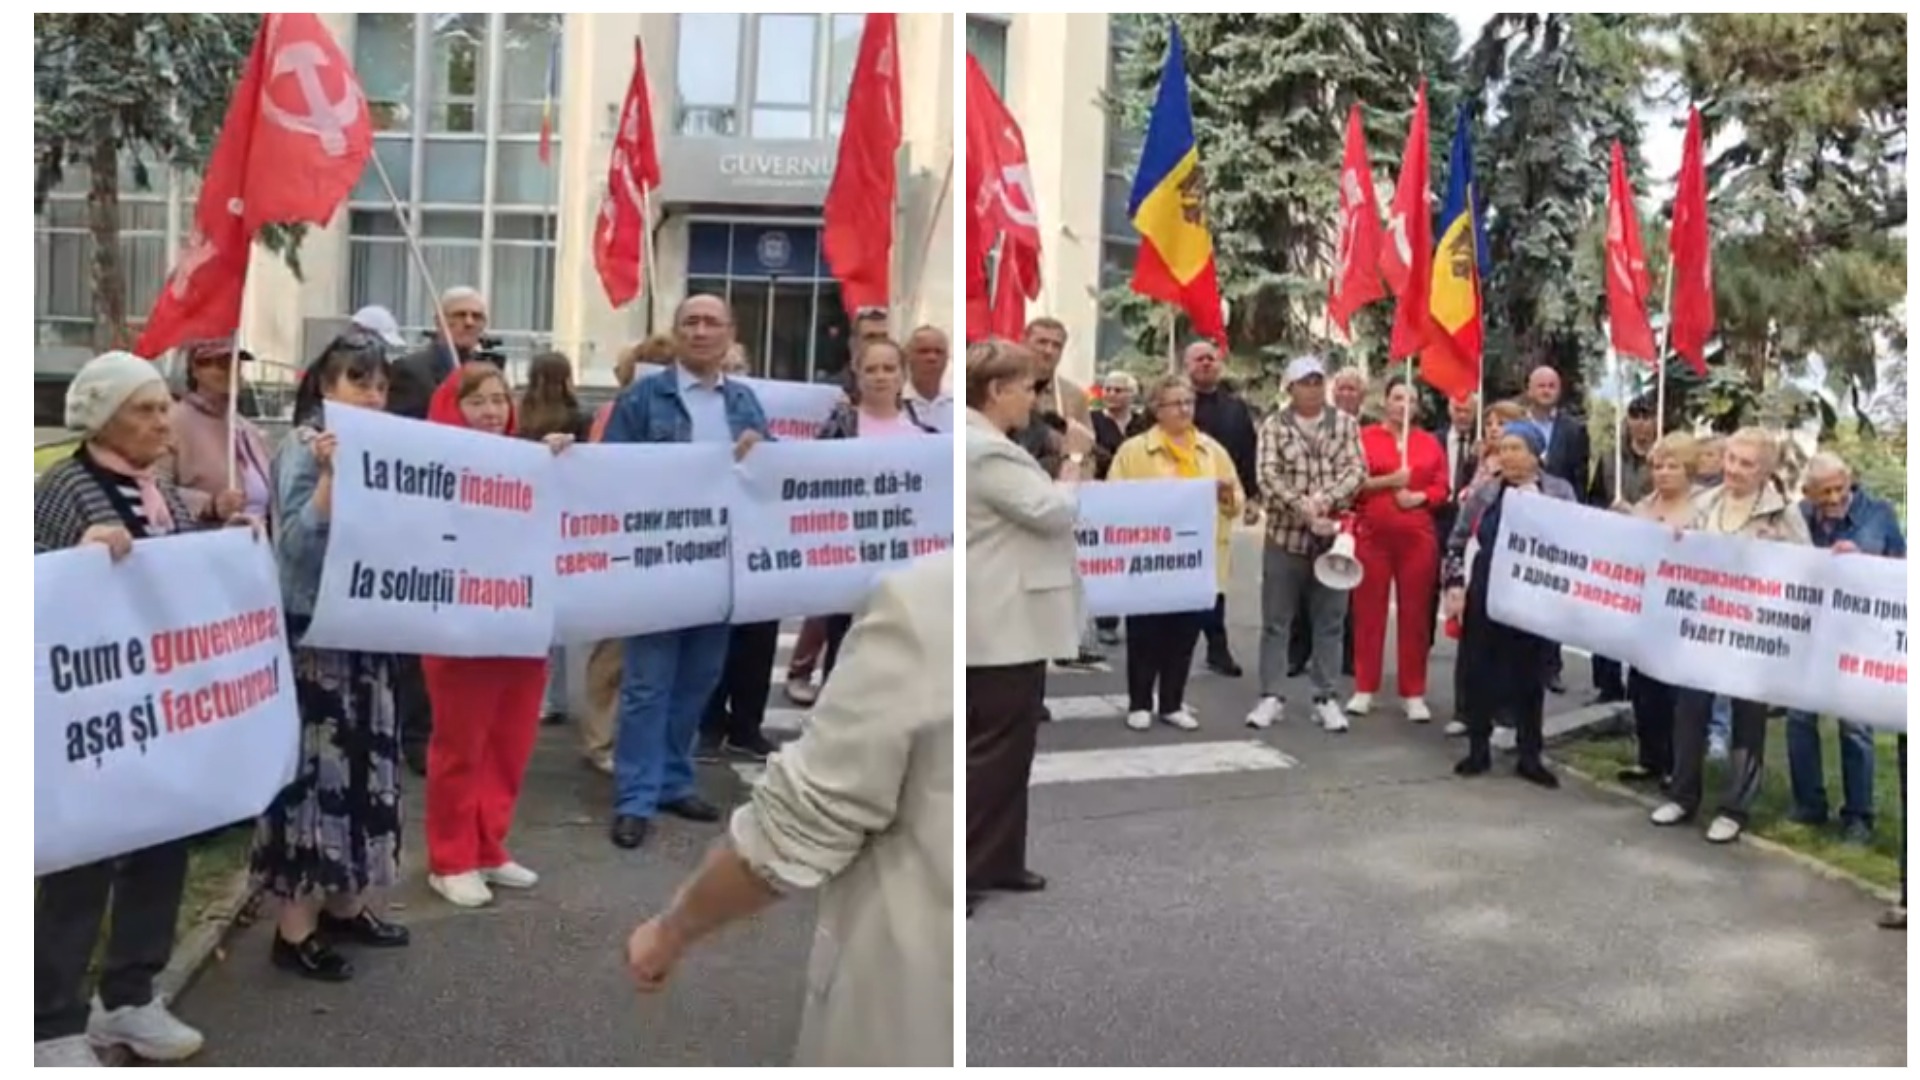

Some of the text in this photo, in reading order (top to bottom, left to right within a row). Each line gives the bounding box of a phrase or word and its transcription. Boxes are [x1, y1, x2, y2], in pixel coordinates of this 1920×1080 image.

[719, 152, 833, 176] GUVERNU
[362, 450, 389, 490] La
[395, 459, 457, 500] tarife
[560, 511, 620, 539] Готовь
[624, 510, 663, 533] сани
[719, 507, 728, 525] а
[790, 510, 849, 534] minte
[853, 509, 878, 530] un
[1104, 525, 1172, 545] близко
[556, 552, 609, 576] свечи
[634, 546, 664, 569] при
[776, 548, 802, 570] ne
[806, 543, 857, 566] aduc
[860, 540, 886, 562] iar
[891, 539, 908, 560] la
[1129, 549, 1202, 575] далеко!
[1508, 531, 1527, 554] На
[1530, 537, 1589, 571] Тофана
[350, 561, 375, 599] la
[1511, 563, 1521, 579] а
[1523, 566, 1571, 594] дрова
[1833, 588, 1871, 615] Пока
[1680, 618, 1725, 645] будет
[1756, 607, 1812, 634] зимой
[50, 605, 279, 693] Cum e guvernarea
[66, 711, 124, 768] așa
[130, 694, 159, 755] și
